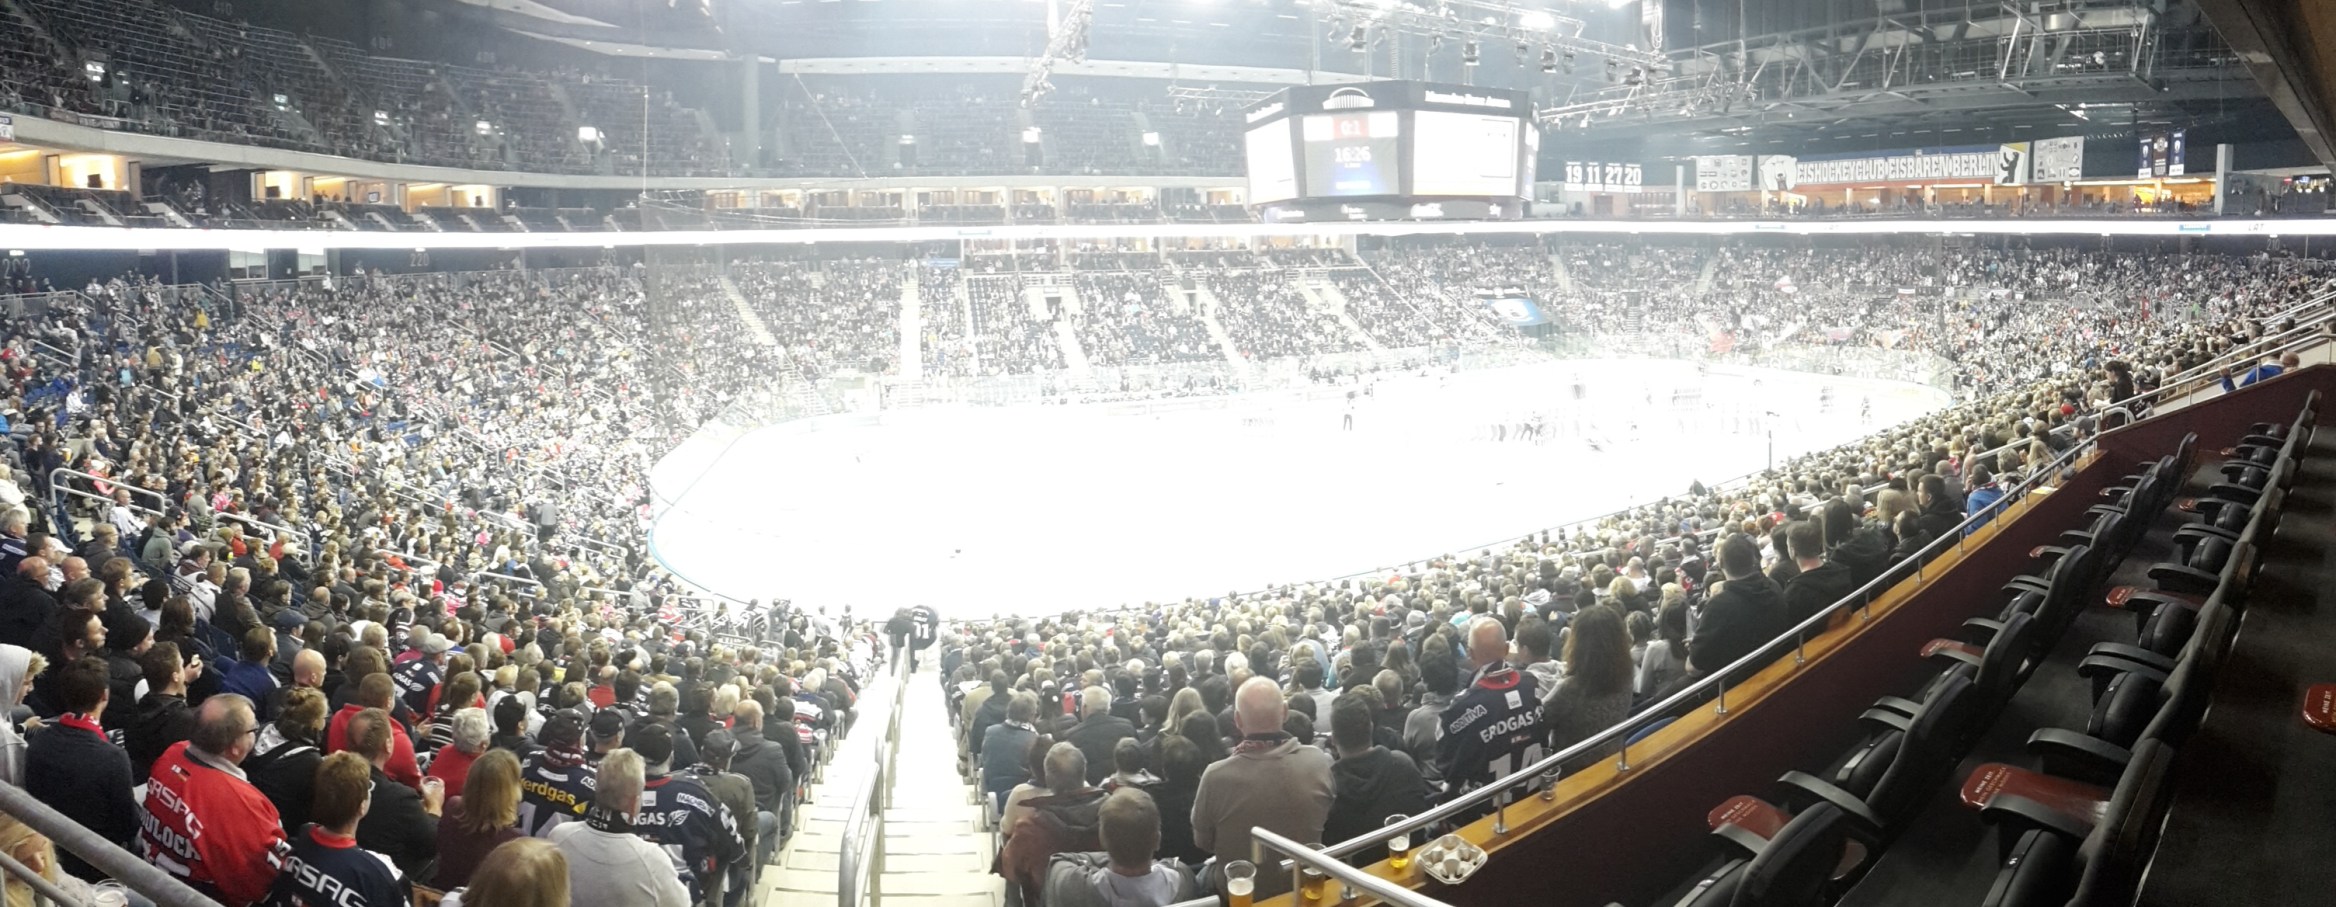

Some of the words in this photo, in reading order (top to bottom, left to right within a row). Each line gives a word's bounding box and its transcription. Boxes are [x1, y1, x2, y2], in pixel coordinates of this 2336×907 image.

[1566, 165, 1582, 183] 19
[1587, 166, 1600, 183] 11
[1605, 166, 1623, 184] 27
[1624, 167, 1642, 185] 20
[1797, 158, 1885, 183] EISHOCKEYCLUB
[1887, 149, 1949, 179] EISBÄREN
[1952, 153, 2000, 177] BERLIN
[1480, 711, 1535, 743] ERDGAS
